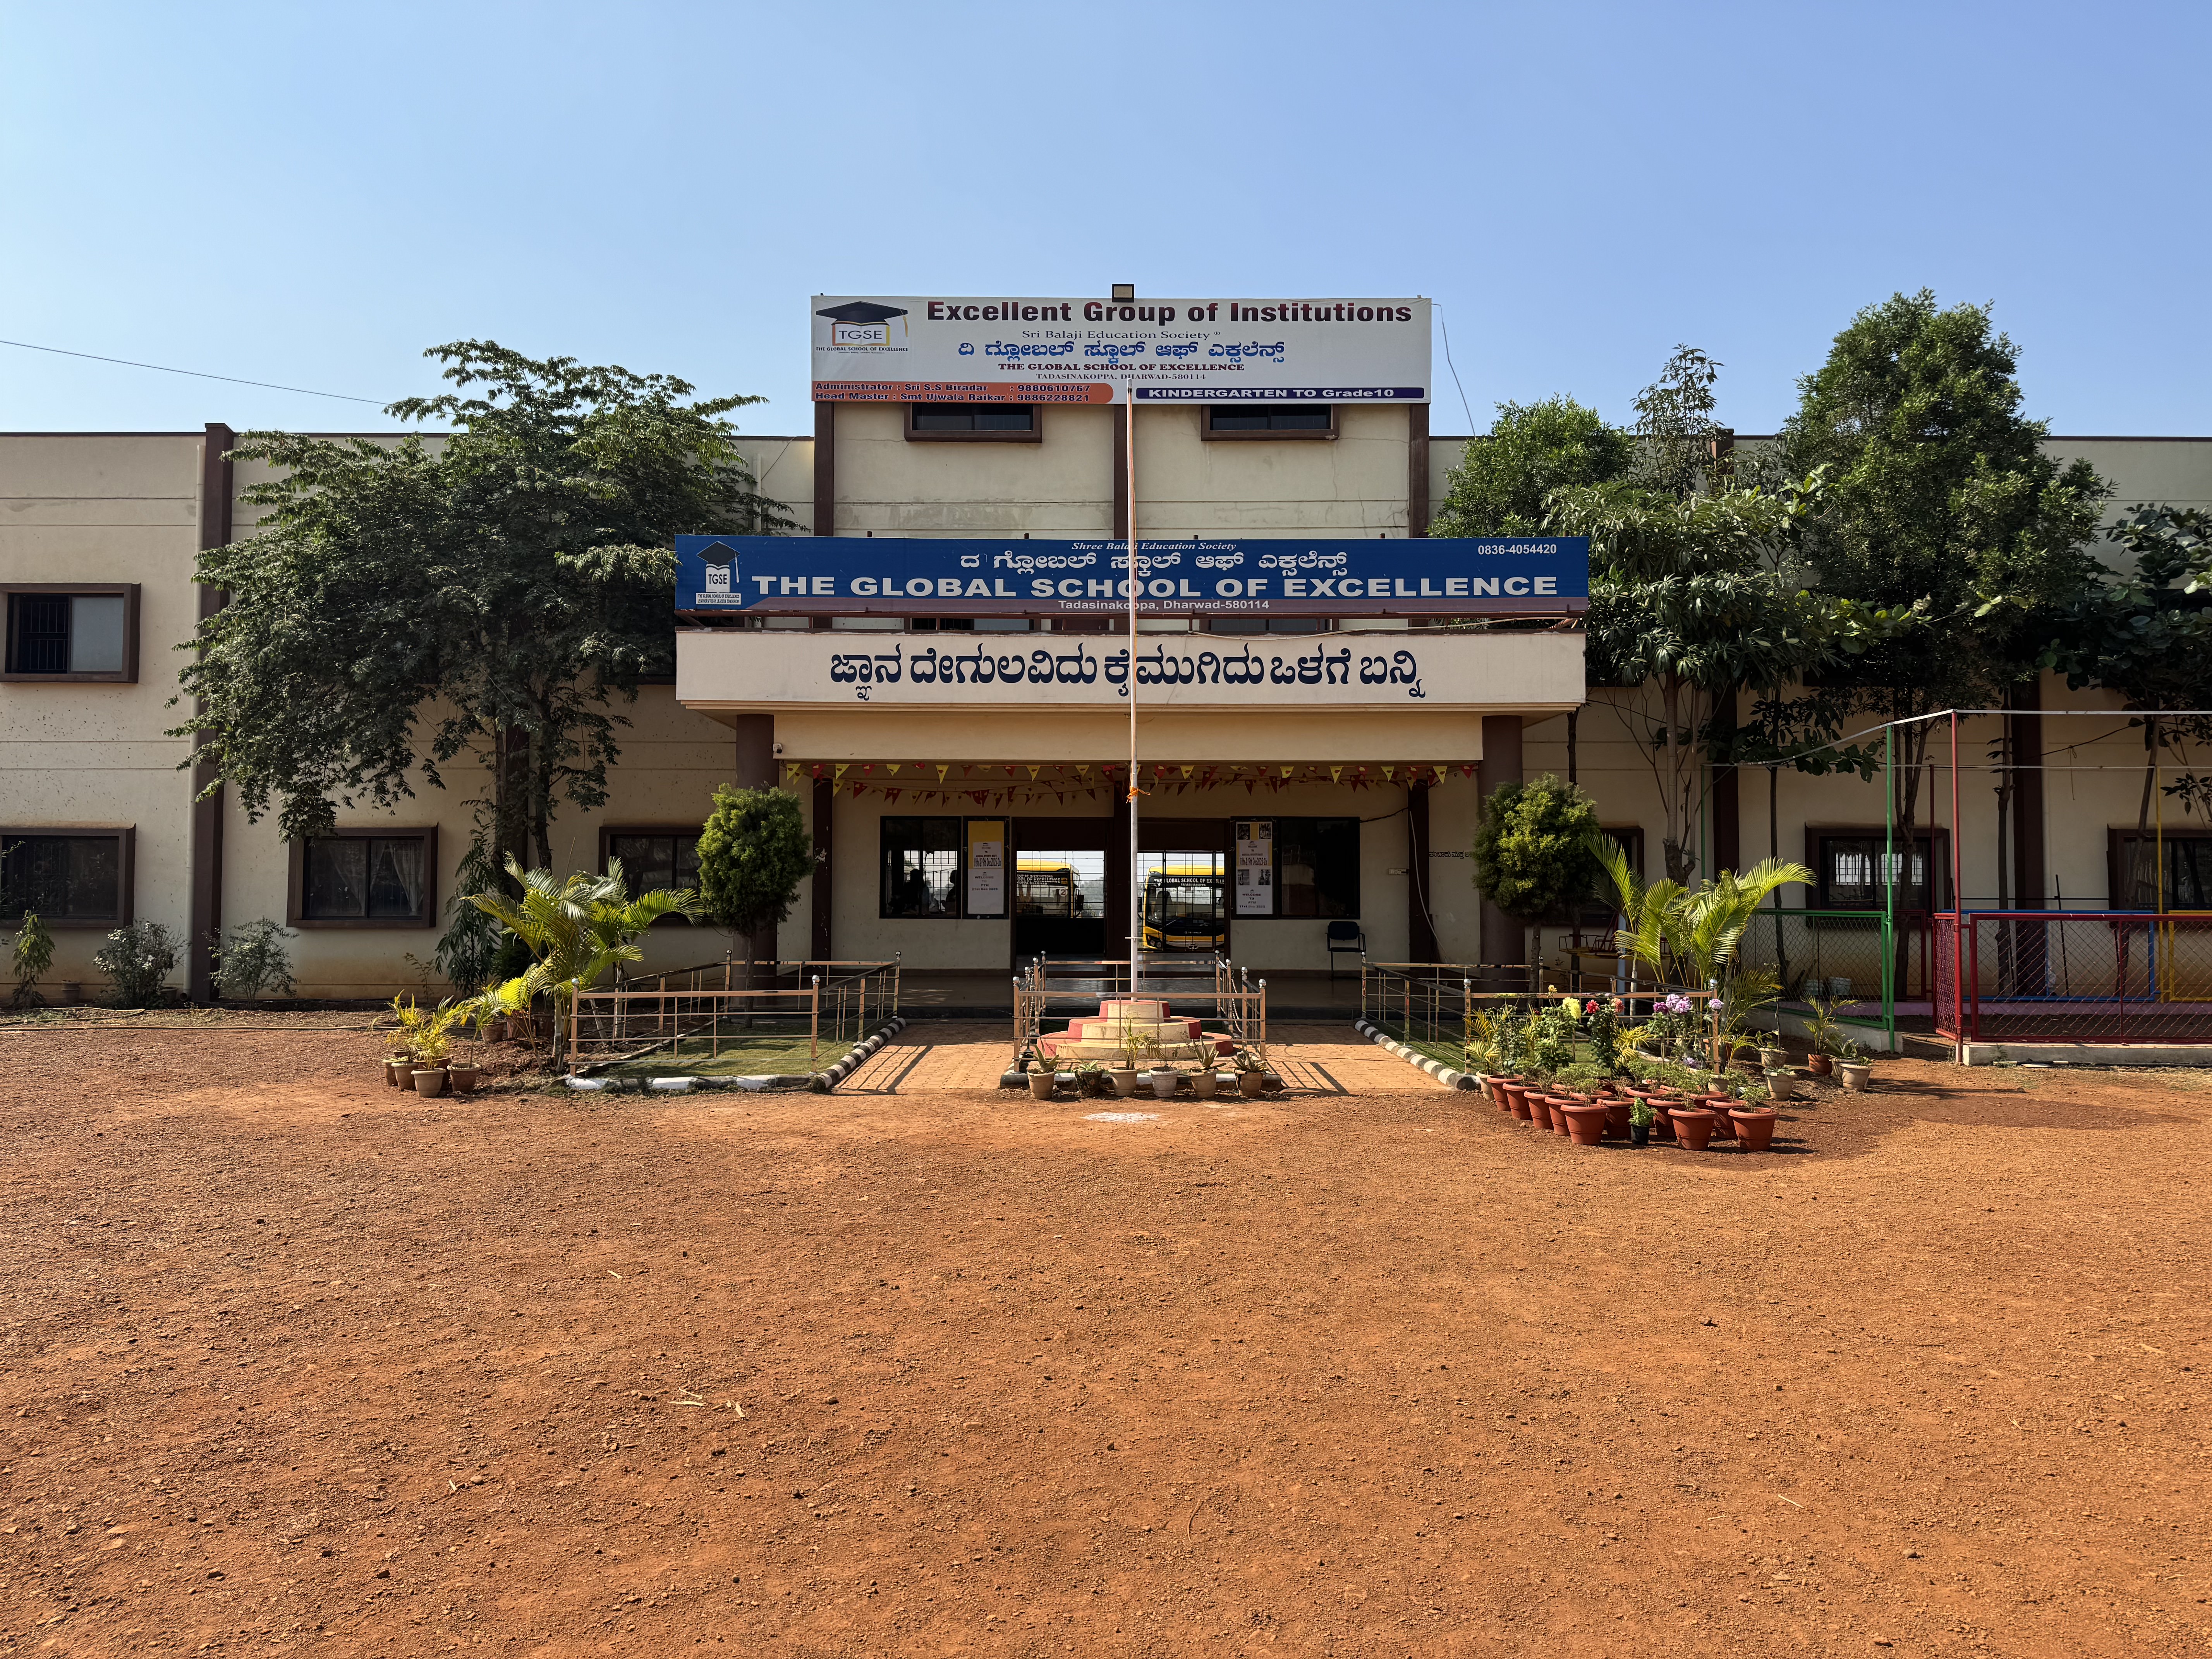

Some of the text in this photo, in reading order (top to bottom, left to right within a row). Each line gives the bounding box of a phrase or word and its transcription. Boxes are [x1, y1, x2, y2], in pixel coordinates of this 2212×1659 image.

[927, 301, 1412, 326] Excellent Group of Institutions
[838, 330, 882, 339] TGSE
[1045, 330, 1082, 340] Balaji
[1161, 331, 1210, 340] Society
[958, 340, 1285, 364] ದಿ ಗ್ಲೋಬಲ್ ಸ್ಕೂಲ್ ಆಫ್ ಎಕ್ಸಲೆನ್ಸ್
[926, 393, 964, 402] Ujwala
[1149, 388, 1395, 398] KINDERGARTEN TO Grade10
[1141, 542, 1197, 550] Education
[1198, 543, 1237, 551] Society
[1478, 544, 1557, 555] 0836-4054420
[960, 553, 980, 568] ದ
[993, 550, 1096, 575] ಗ್ಲೋಬಲ್
[1195, 551, 1244, 571] ಆಫ್
[1258, 550, 1348, 576] ಎಕ್ಸಲೆನ್ಸ್
[708, 574, 727, 585] TGSE
[751, 576, 1558, 598] THE GLOBAL SCHOOL OF EXCELLENCE
[1163, 600, 1270, 610] Dharwad-580114
[830, 642, 902, 701] ಜ್ಞಾನ
[910, 642, 1097, 684] ದೇಗುಲವಿದು
[1270, 642, 1351, 685] ಒಳಗೆ
[1360, 650, 1426, 698] ಬನ್ನಿ
